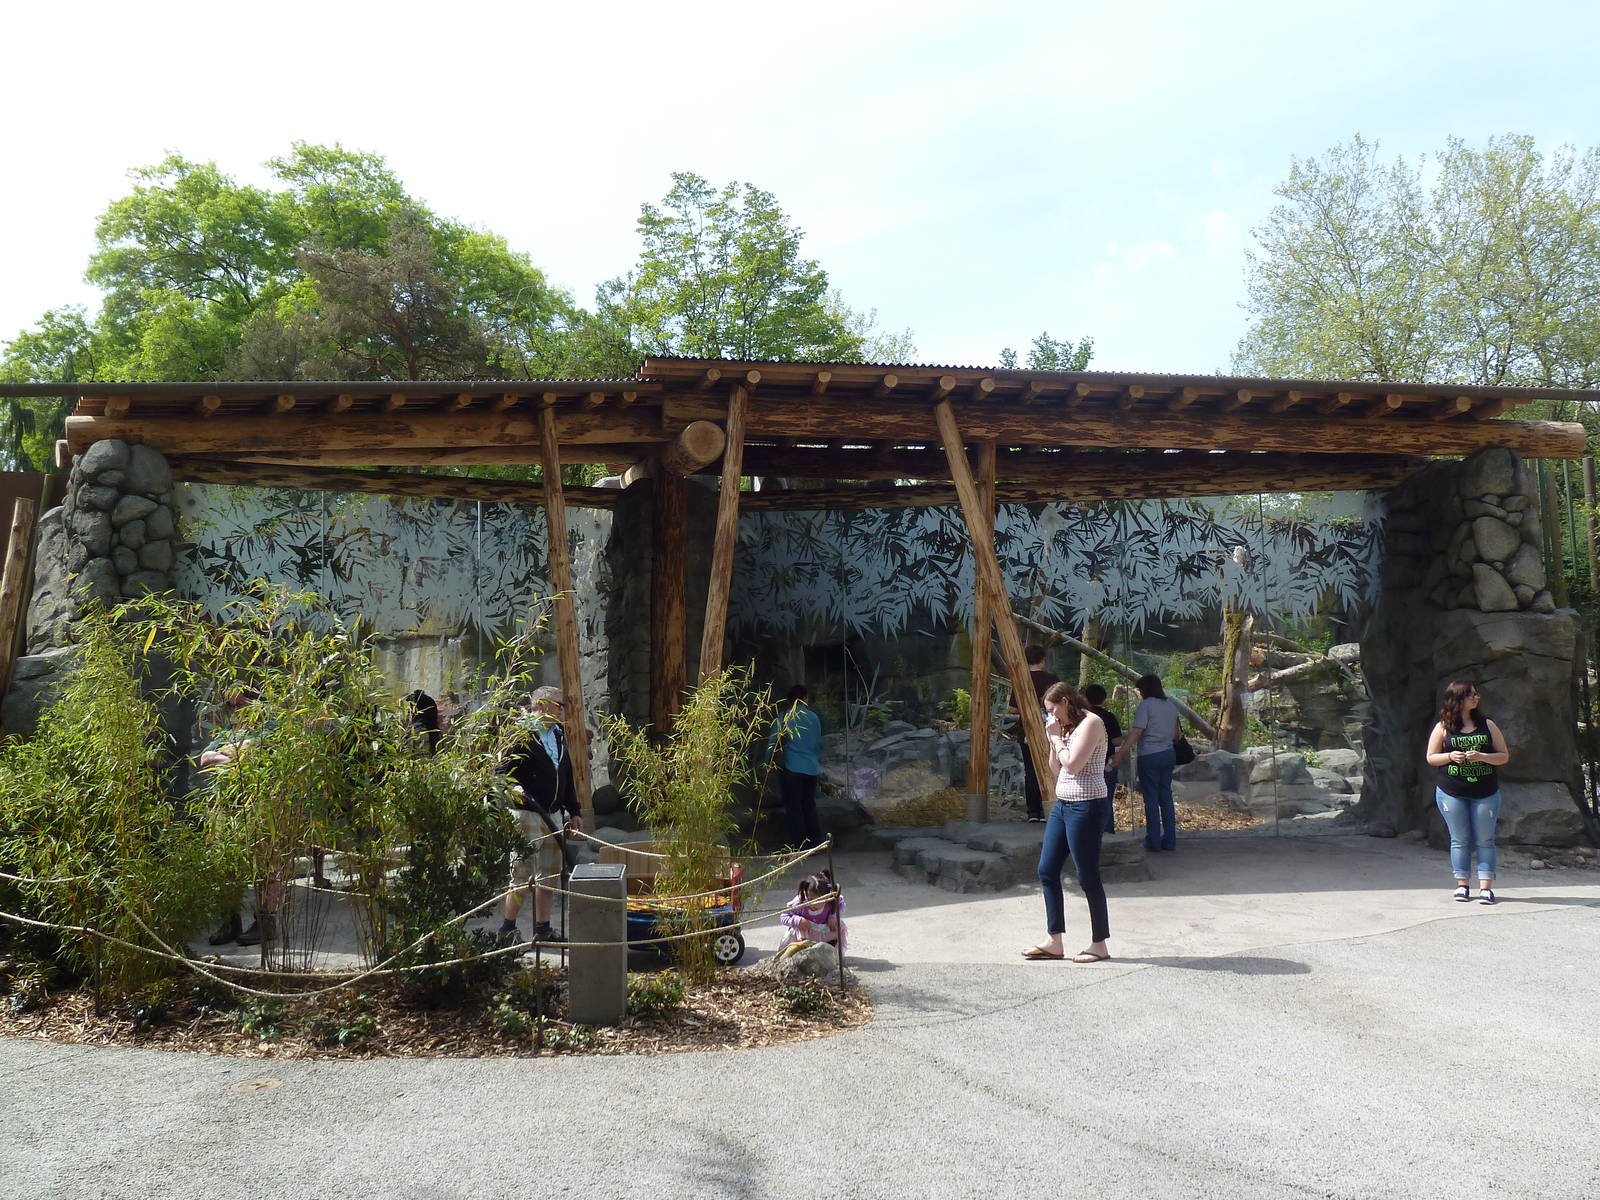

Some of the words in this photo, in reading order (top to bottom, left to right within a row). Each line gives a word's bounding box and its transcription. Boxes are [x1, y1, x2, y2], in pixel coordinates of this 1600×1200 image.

[1451, 737, 1457, 748] I
[1457, 735, 1488, 747] KNOW
[1447, 765, 1458, 776] IS
